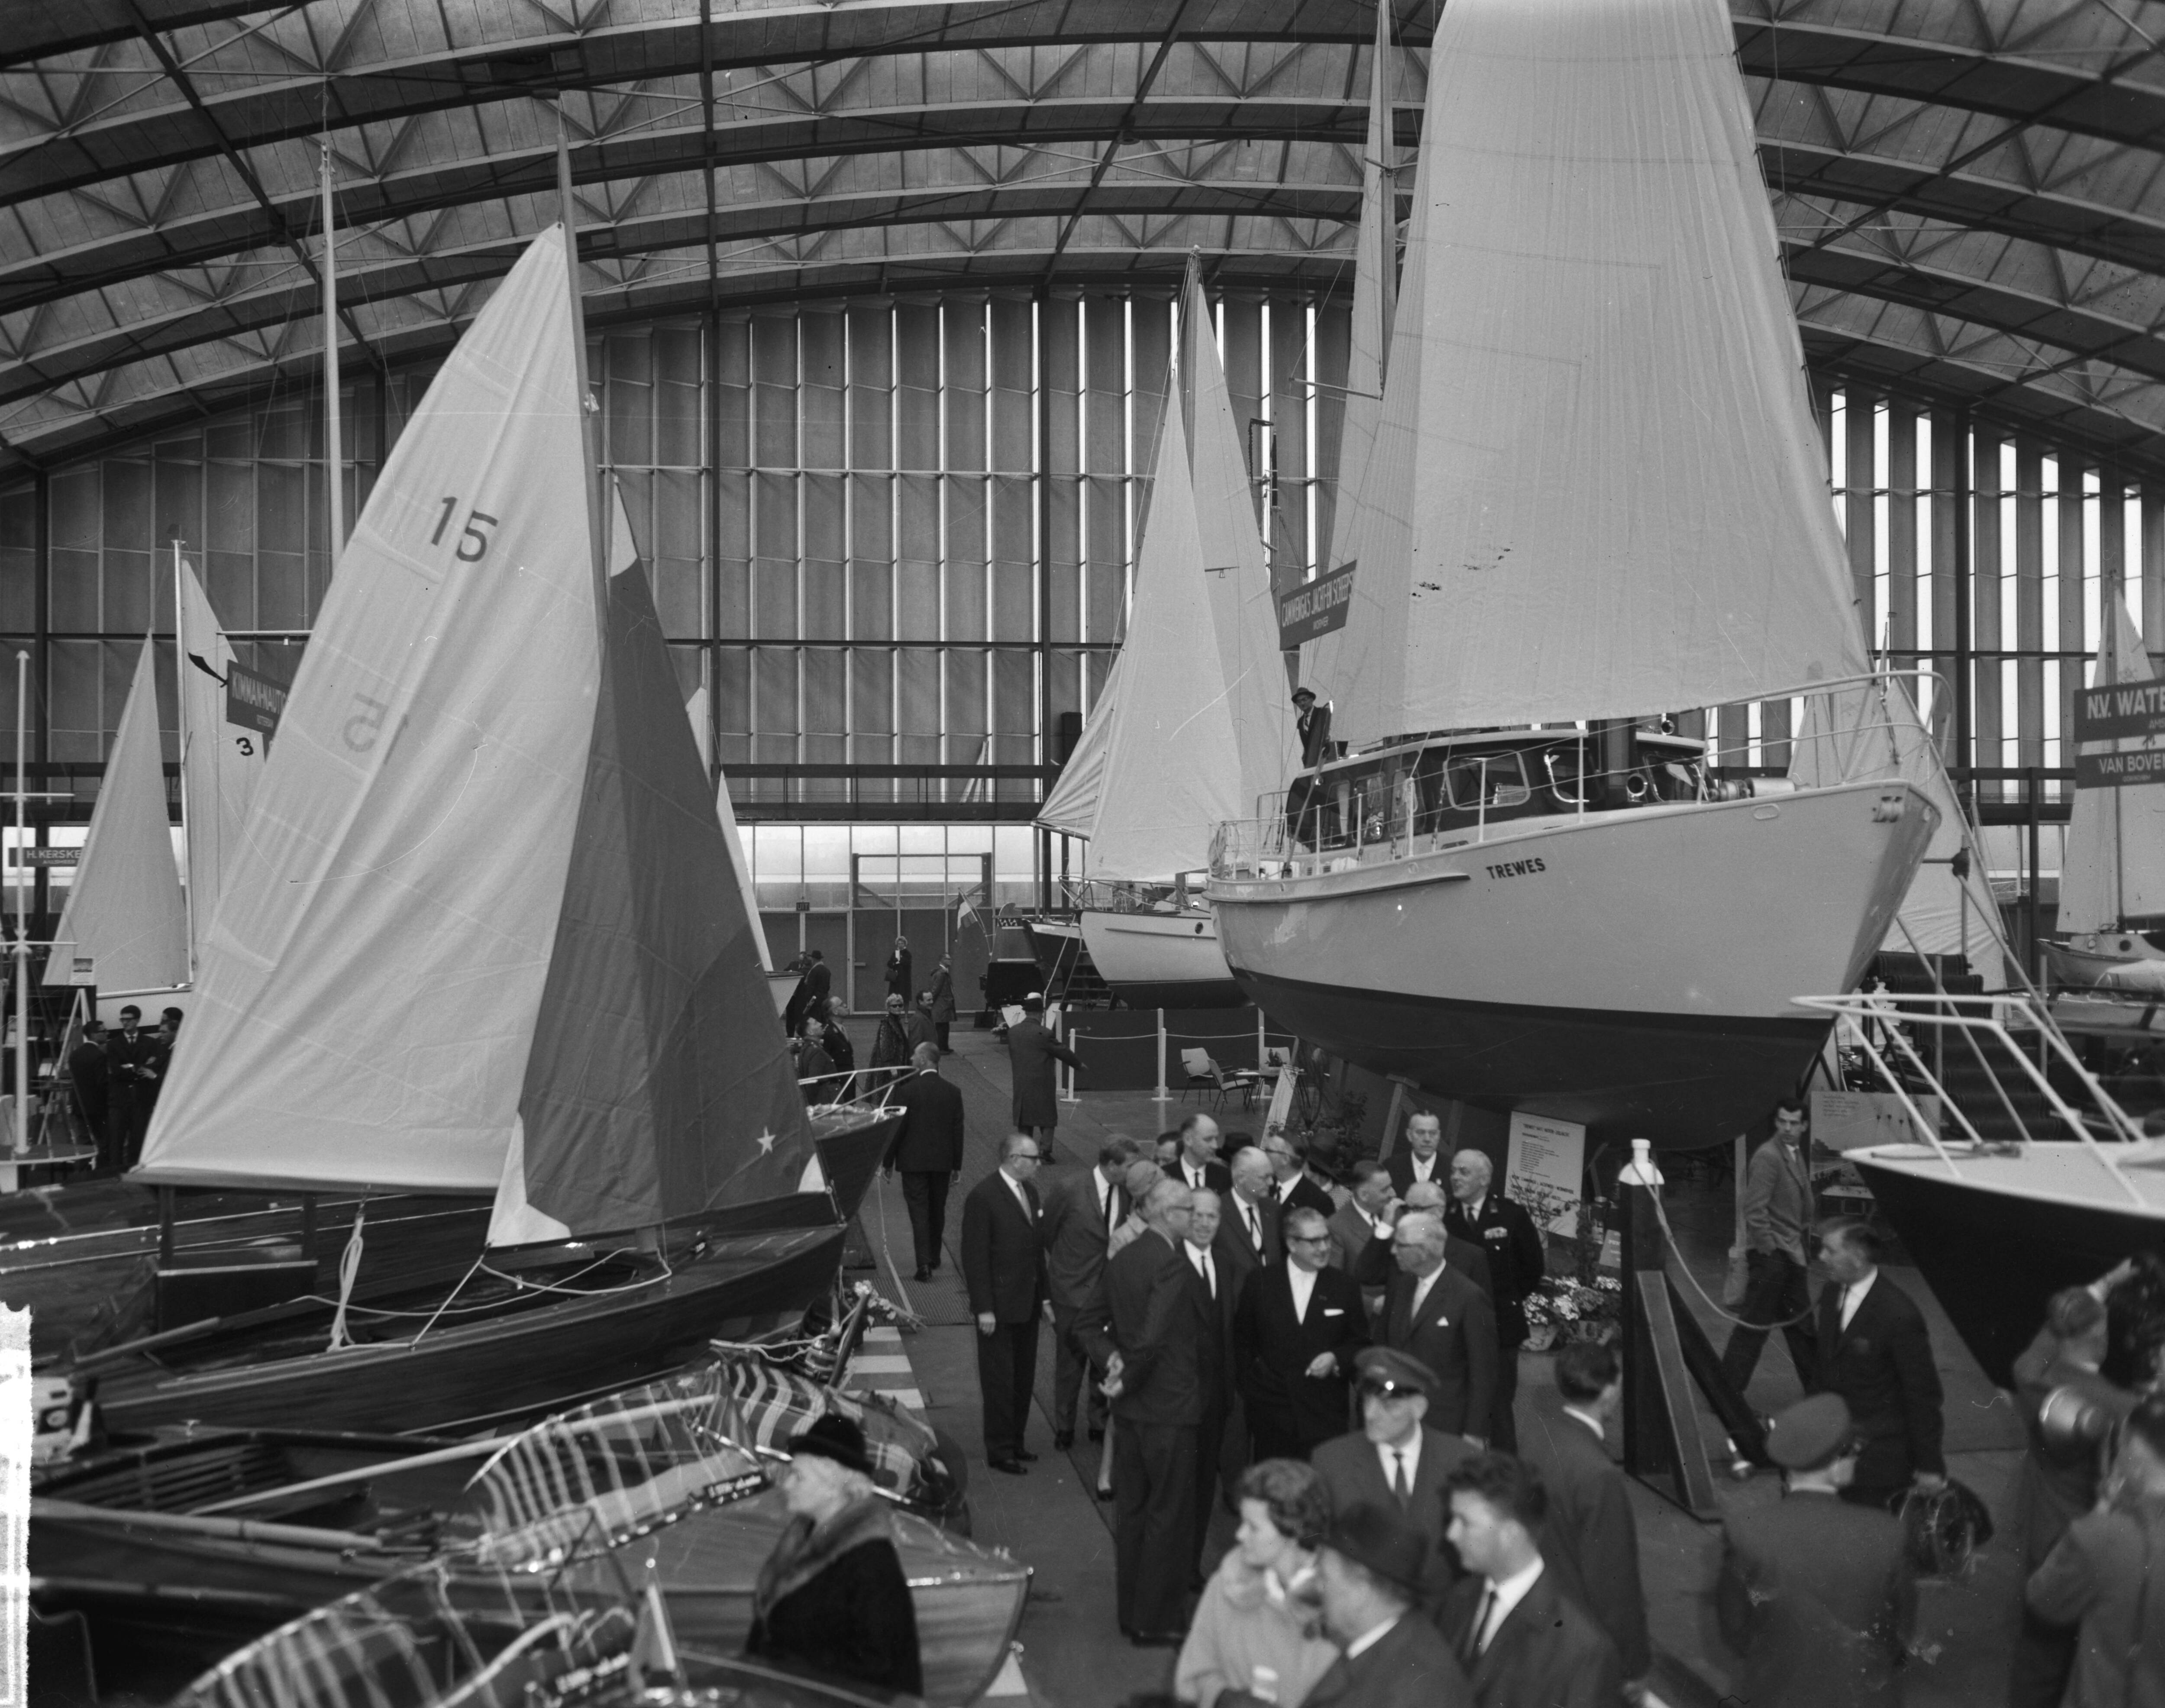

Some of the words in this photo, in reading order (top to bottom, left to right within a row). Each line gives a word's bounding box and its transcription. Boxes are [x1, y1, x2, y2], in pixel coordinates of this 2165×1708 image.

[431, 496, 498, 562] 15
[236, 737, 254, 756] 3
[2099, 756, 2123, 774] VAN
[1486, 857, 1546, 879] TREWES
